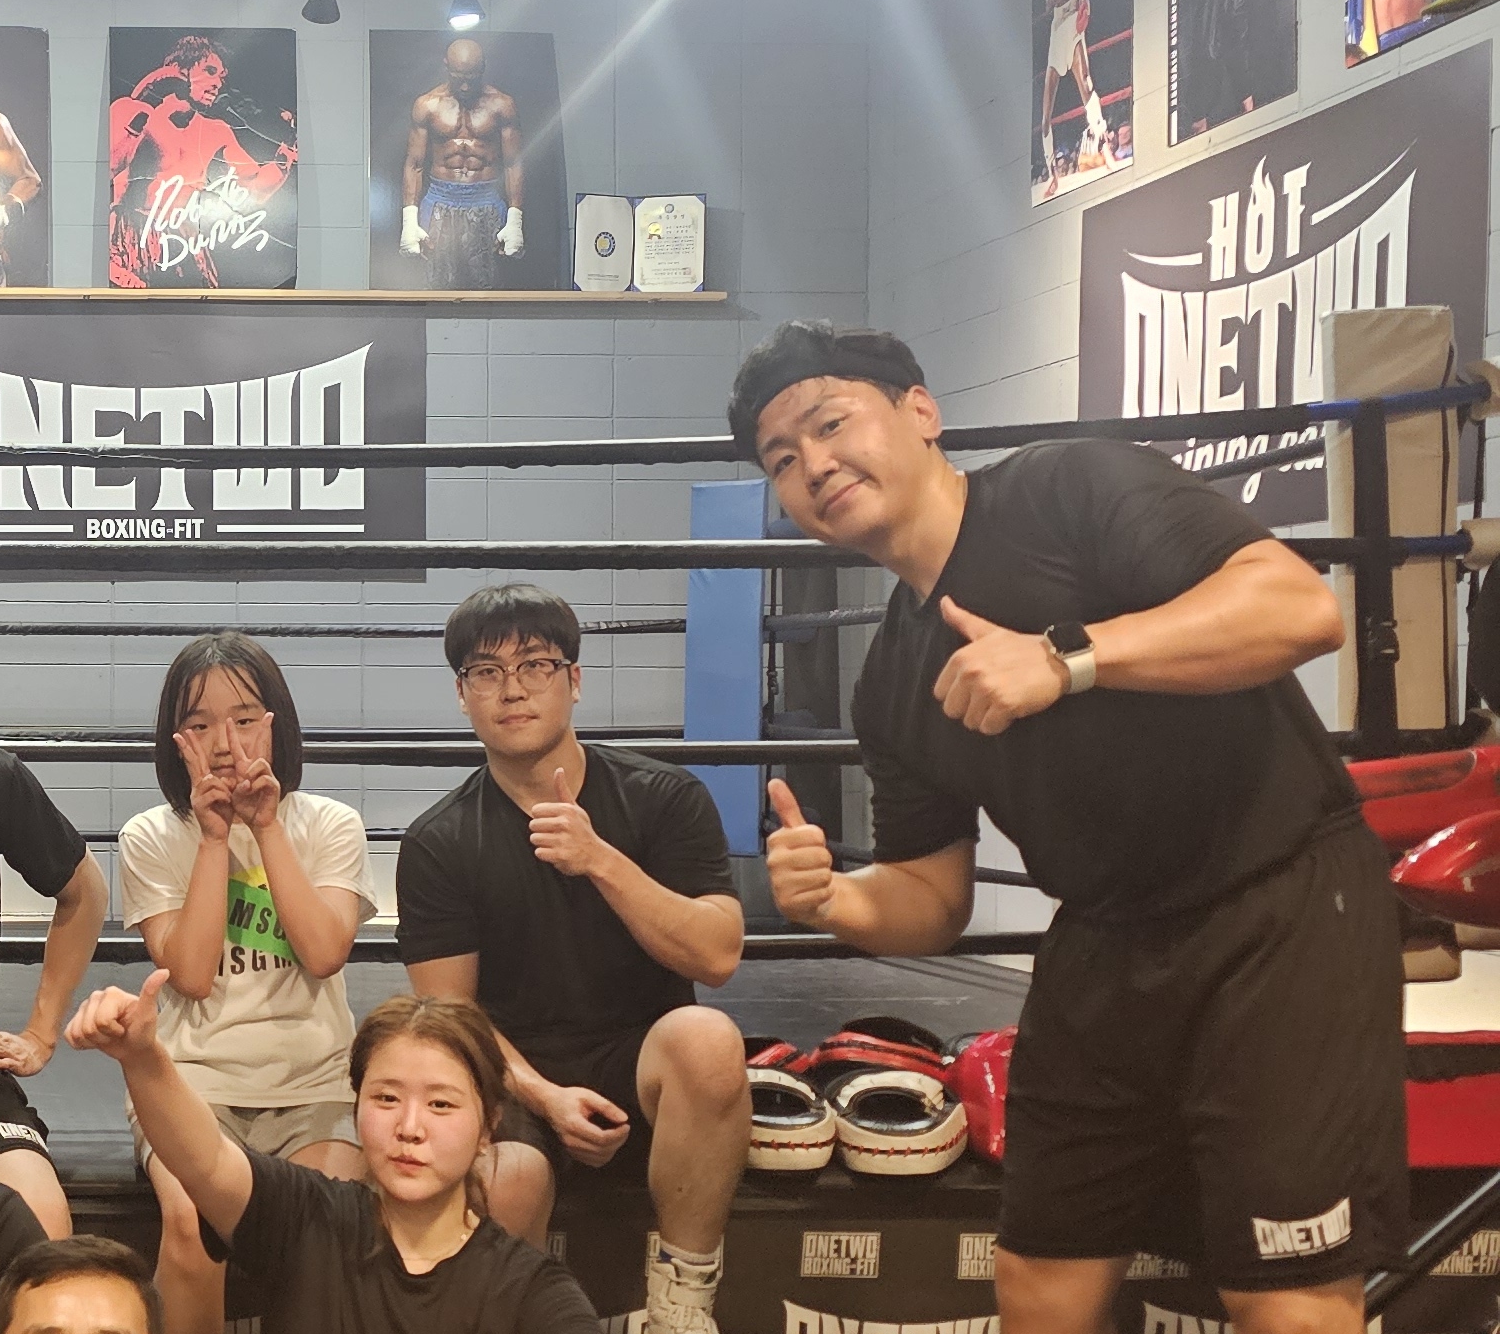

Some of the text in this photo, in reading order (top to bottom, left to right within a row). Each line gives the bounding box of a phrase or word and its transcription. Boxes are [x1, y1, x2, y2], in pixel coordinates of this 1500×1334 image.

[1207, 155, 1312, 281] HOT
[86, 517, 205, 541] BOXING-FIT
[1252, 1197, 1352, 1258] ONETWO
[805, 1234, 878, 1258] ONETWO
[803, 1257, 877, 1276] BOXING-FIT
